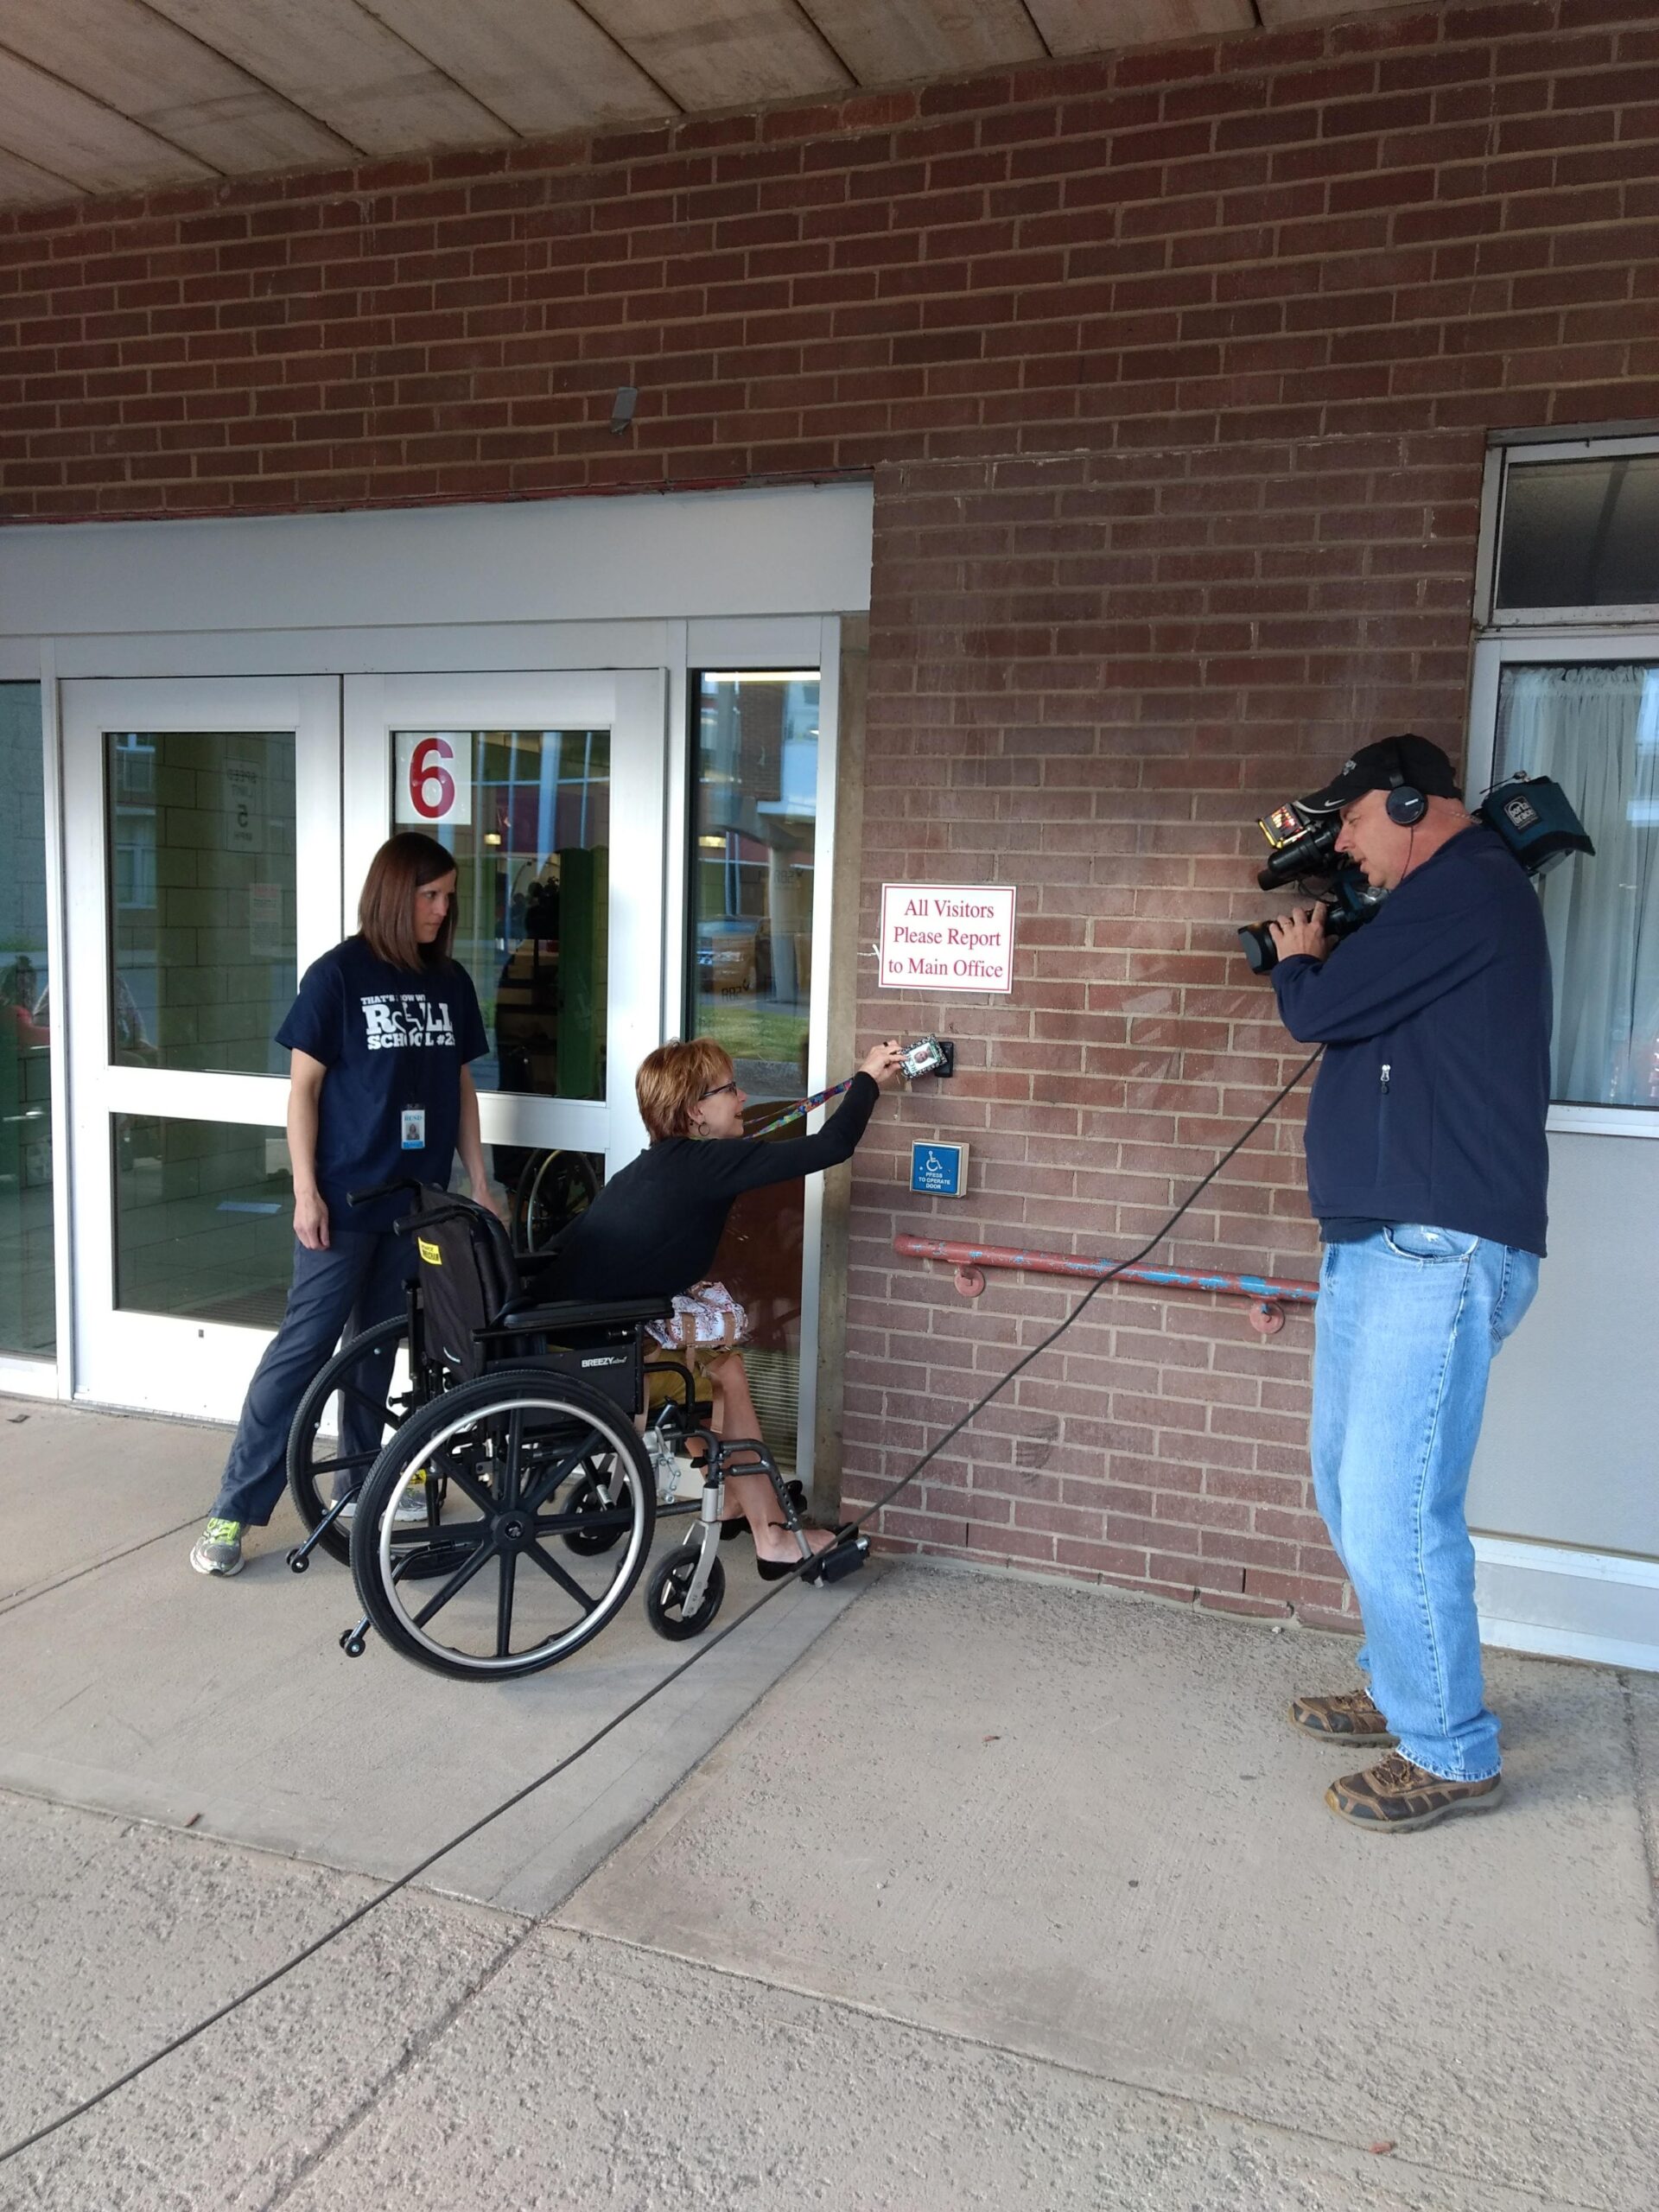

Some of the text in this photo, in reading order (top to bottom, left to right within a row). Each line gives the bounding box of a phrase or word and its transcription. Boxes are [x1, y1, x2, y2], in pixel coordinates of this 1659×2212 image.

[409, 737, 455, 818] 6
[904, 899, 995, 918] All Visitors
[893, 926, 1001, 950] Please Report
[888, 957, 1003, 977] to Main Office
[360, 995, 395, 1005] THAT'S
[926, 1177, 951, 1185] OPERATE
[582, 1357, 614, 1368] BREEZY
